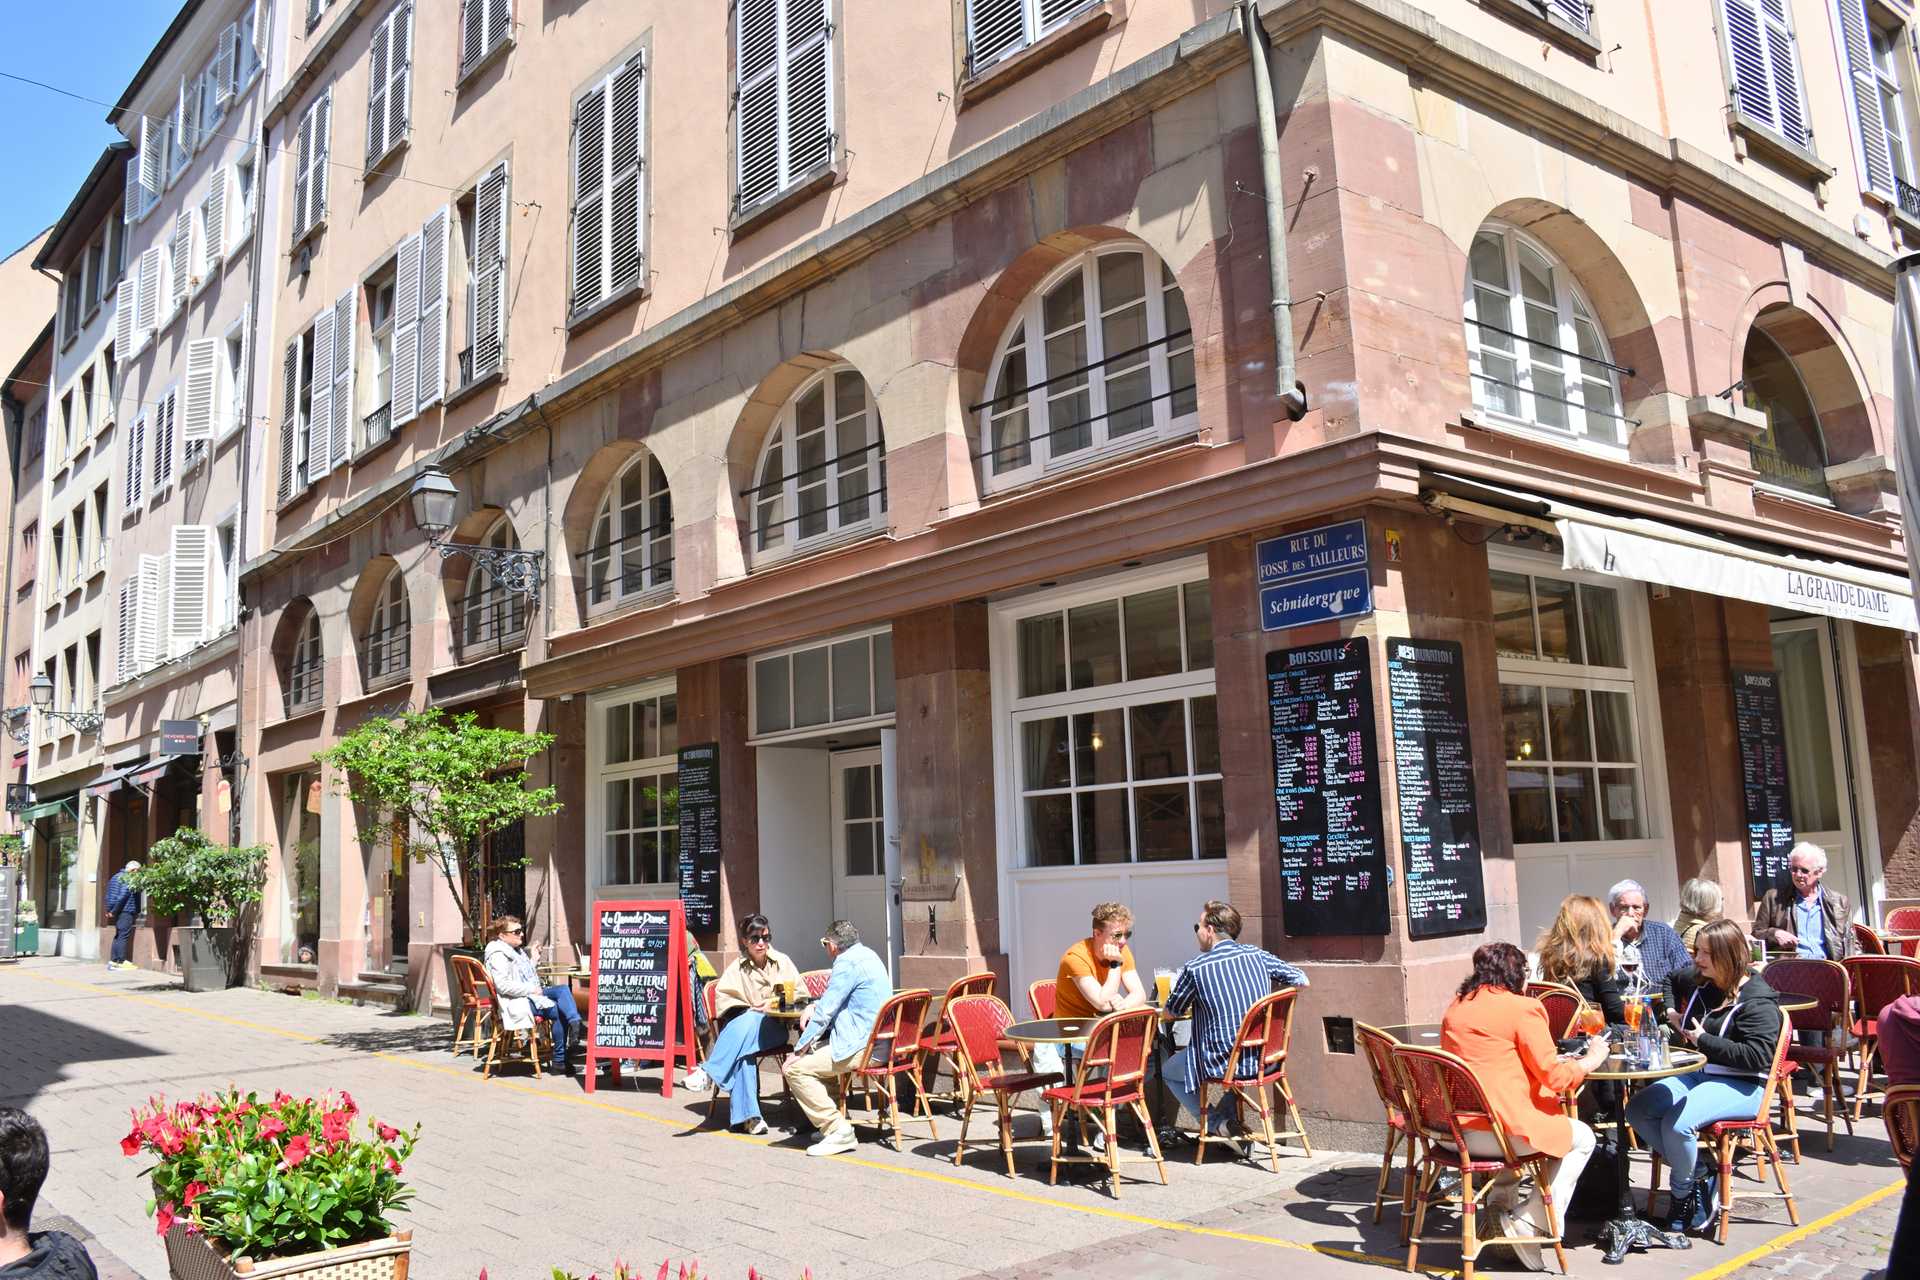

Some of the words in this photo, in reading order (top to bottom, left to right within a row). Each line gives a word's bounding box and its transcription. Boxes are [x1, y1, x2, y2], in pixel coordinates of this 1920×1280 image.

[1290, 537, 1310, 553] RUE
[1314, 533, 1328, 548] DU
[1260, 560, 1289, 578] FOSSE
[1292, 561, 1306, 571] DES
[1309, 544, 1365, 568] TAILLEURS
[1787, 572, 1804, 596] LA
[1806, 576, 1856, 606] GRANDE
[1857, 588, 1889, 613] DAME
[1270, 587, 1361, 614] Schnidergrwe
[600, 937, 645, 949] HOMEMADE
[600, 949, 622, 959] FOOD
[599, 960, 616, 969] FAIT
[618, 960, 654, 970] MAISON
[598, 975, 615, 986] BAR
[616, 975, 623, 986] &
[625, 975, 667, 990] CAFETERIA
[597, 1004, 646, 1016] RESTAURANT
[597, 1025, 624, 1035] DINING
[626, 1025, 651, 1037] ROOM
[596, 1035, 636, 1047] UPSTAIRS
